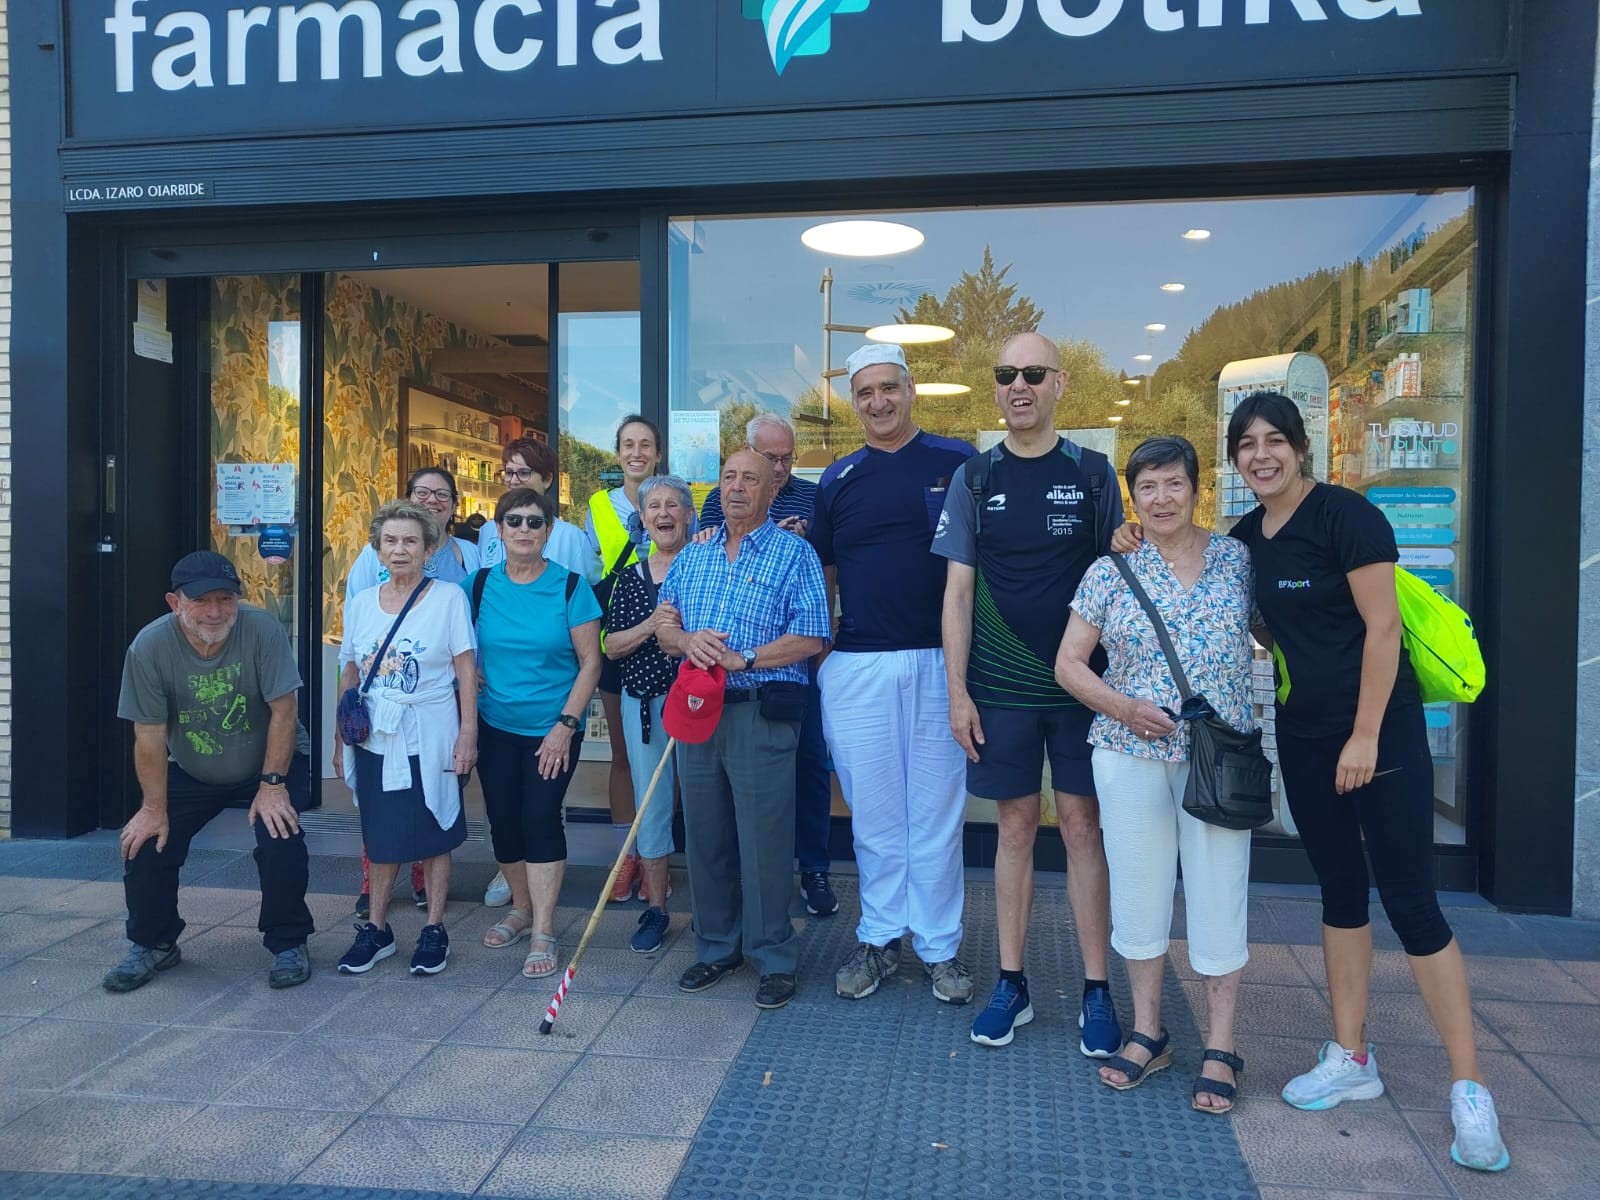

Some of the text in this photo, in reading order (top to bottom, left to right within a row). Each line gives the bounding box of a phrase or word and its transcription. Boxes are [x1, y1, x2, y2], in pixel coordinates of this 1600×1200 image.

[104, 0, 664, 92] farmacia
[69, 183, 206, 201] LCDA. IZARO OIARBIDE
[1368, 422, 1458, 437] TU SALUD
[1046, 489, 1084, 500] alkain
[1052, 527, 1073, 535] 2015
